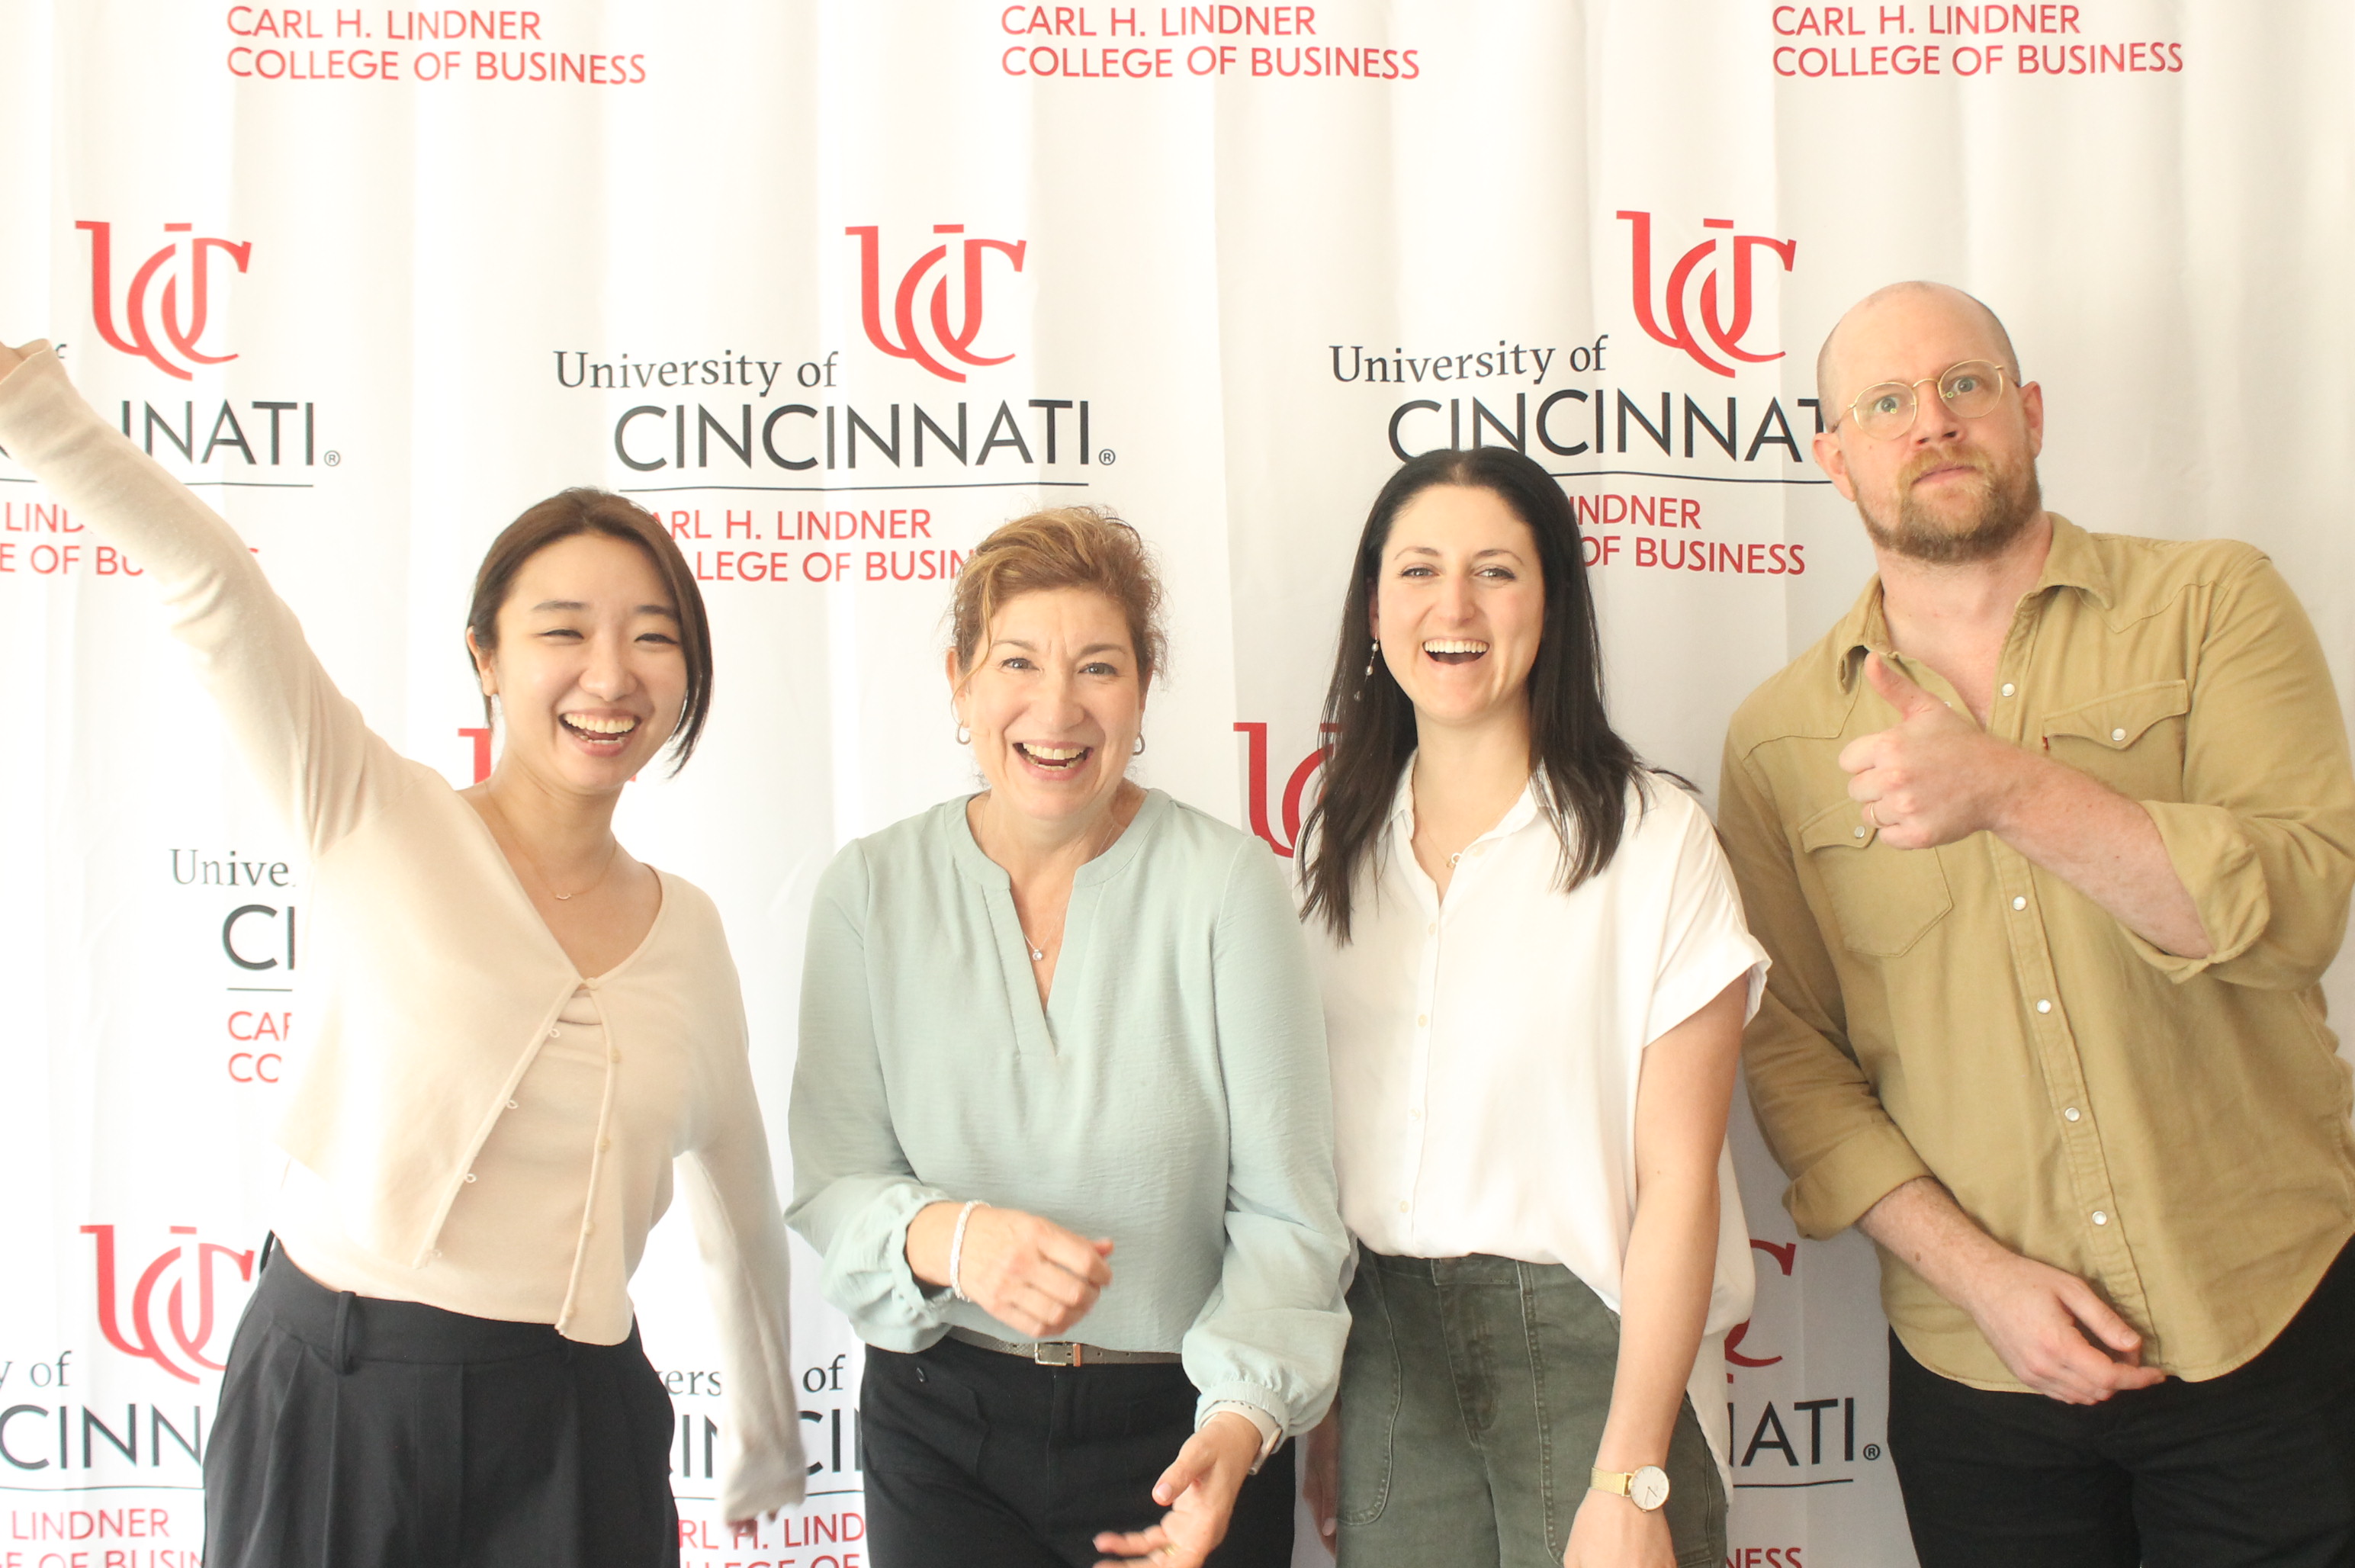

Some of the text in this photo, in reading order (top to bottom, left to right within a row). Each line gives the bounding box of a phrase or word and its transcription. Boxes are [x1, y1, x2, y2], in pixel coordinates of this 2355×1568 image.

[227, 6, 541, 40] CARL H. LINDNER
[1002, 5, 1316, 37] CARL H. LINDNER
[1772, 4, 2081, 37] CARL H. LINDNER
[227, 47, 646, 85] COLLEGE OF BUSINESS
[1002, 46, 1419, 79] COLLEGE OF BUSINESS
[1772, 41, 2183, 78] COLLEGE OF BUSINESS
[554, 350, 838, 397] University of
[1329, 335, 1608, 384] University of
[727, 509, 761, 540] H.
[778, 509, 932, 541] LINDNER
[1569, 494, 1701, 530] INDNER
[31, 545, 81, 574] OF
[802, 552, 851, 583] OF
[1581, 535, 1806, 575] OF BUSINESS
[31, 1351, 71, 1386] of
[803, 1354, 846, 1393] of
[13, 1509, 169, 1540] LINDNER
[785, 1512, 866, 1547] LIND
